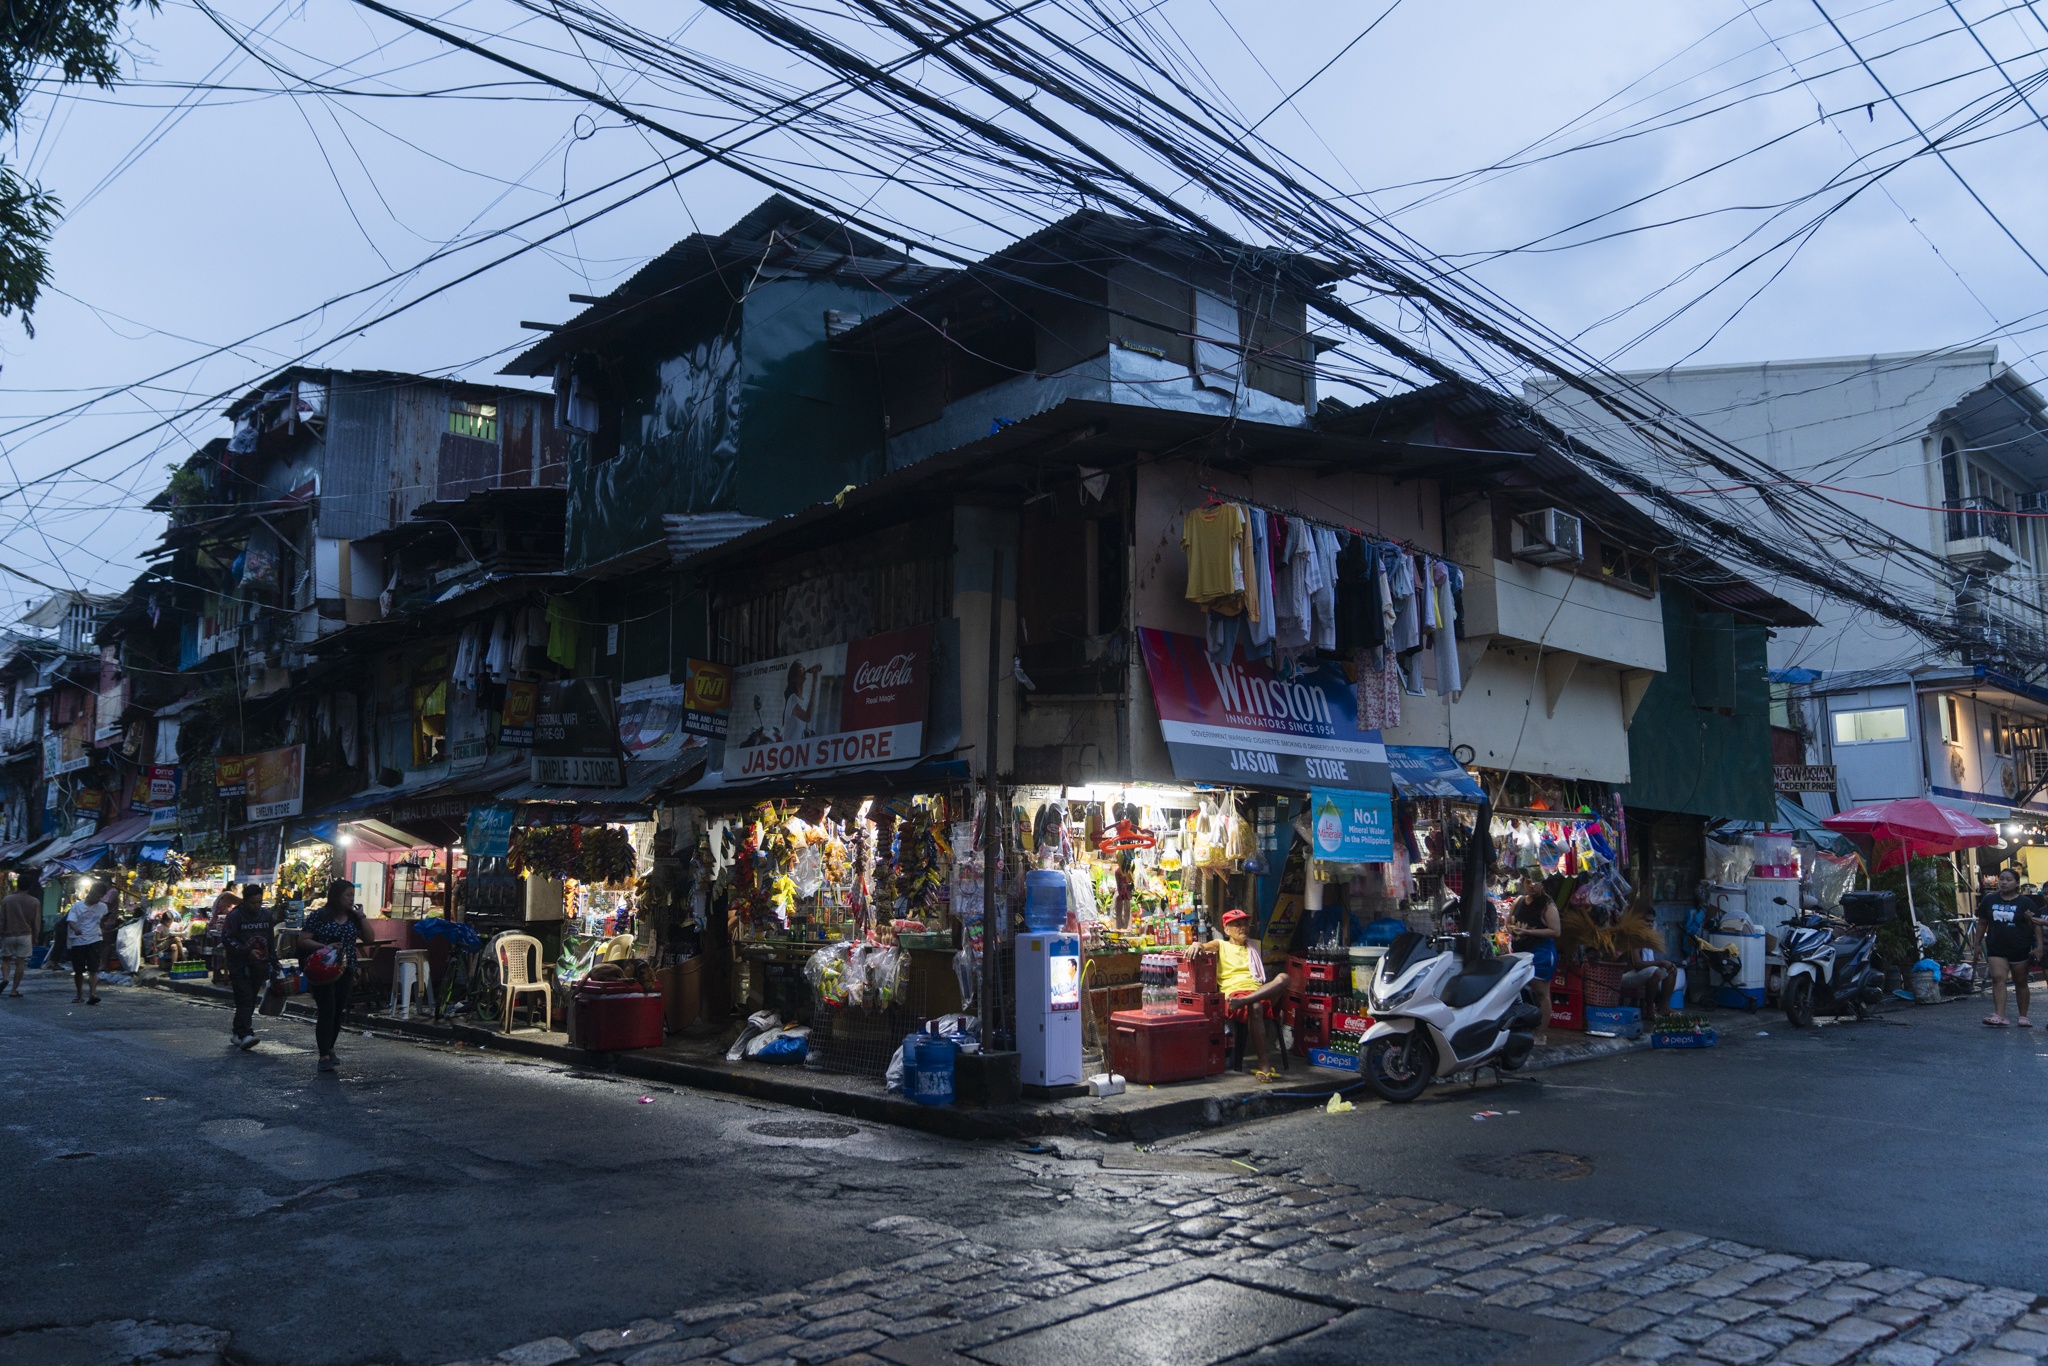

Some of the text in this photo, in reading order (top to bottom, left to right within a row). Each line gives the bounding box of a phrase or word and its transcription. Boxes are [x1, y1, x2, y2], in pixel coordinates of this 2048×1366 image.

[754, 667, 767, 676] time
[769, 662, 787, 673] muna
[853, 652, 917, 693] Coca-Cola
[696, 675, 726, 695] TNT
[1204, 650, 1332, 724] Winston
[512, 696, 531, 712] TNT
[866, 693, 896, 704] Real Magic
[536, 713, 578, 725] PERSONAL WIFI
[688, 713, 727, 727] SIM AND LOAD
[1225, 713, 1335, 736] INNOVATORS SINCE 1954
[685, 720, 714, 732] AVAILABLE
[1253, 737, 1280, 745] CIGARETTE
[1281, 741, 1301, 749] SMOKING
[742, 731, 892, 774] JASON STORE
[222, 762, 241, 777] TNT
[538, 760, 616, 782] TRIPLE J STORE
[1230, 749, 1349, 780] JASON STORE
[1812, 782, 1836, 790] PRONE
[275, 802, 290, 815] STORE
[431, 801, 465, 817] CANTEEN
[1354, 808, 1378, 825] No.1
[1326, 820, 1333, 830] Le
[1348, 825, 1385, 836] Mineral Water
[1317, 829, 1342, 839] Minerale
[1344, 835, 1391, 846] in the Philippines
[1345, 1017, 1367, 1028] Coca-Cola
[1671, 1035, 1694, 1044] pepsi
[1327, 1056, 1351, 1067] pepsi
